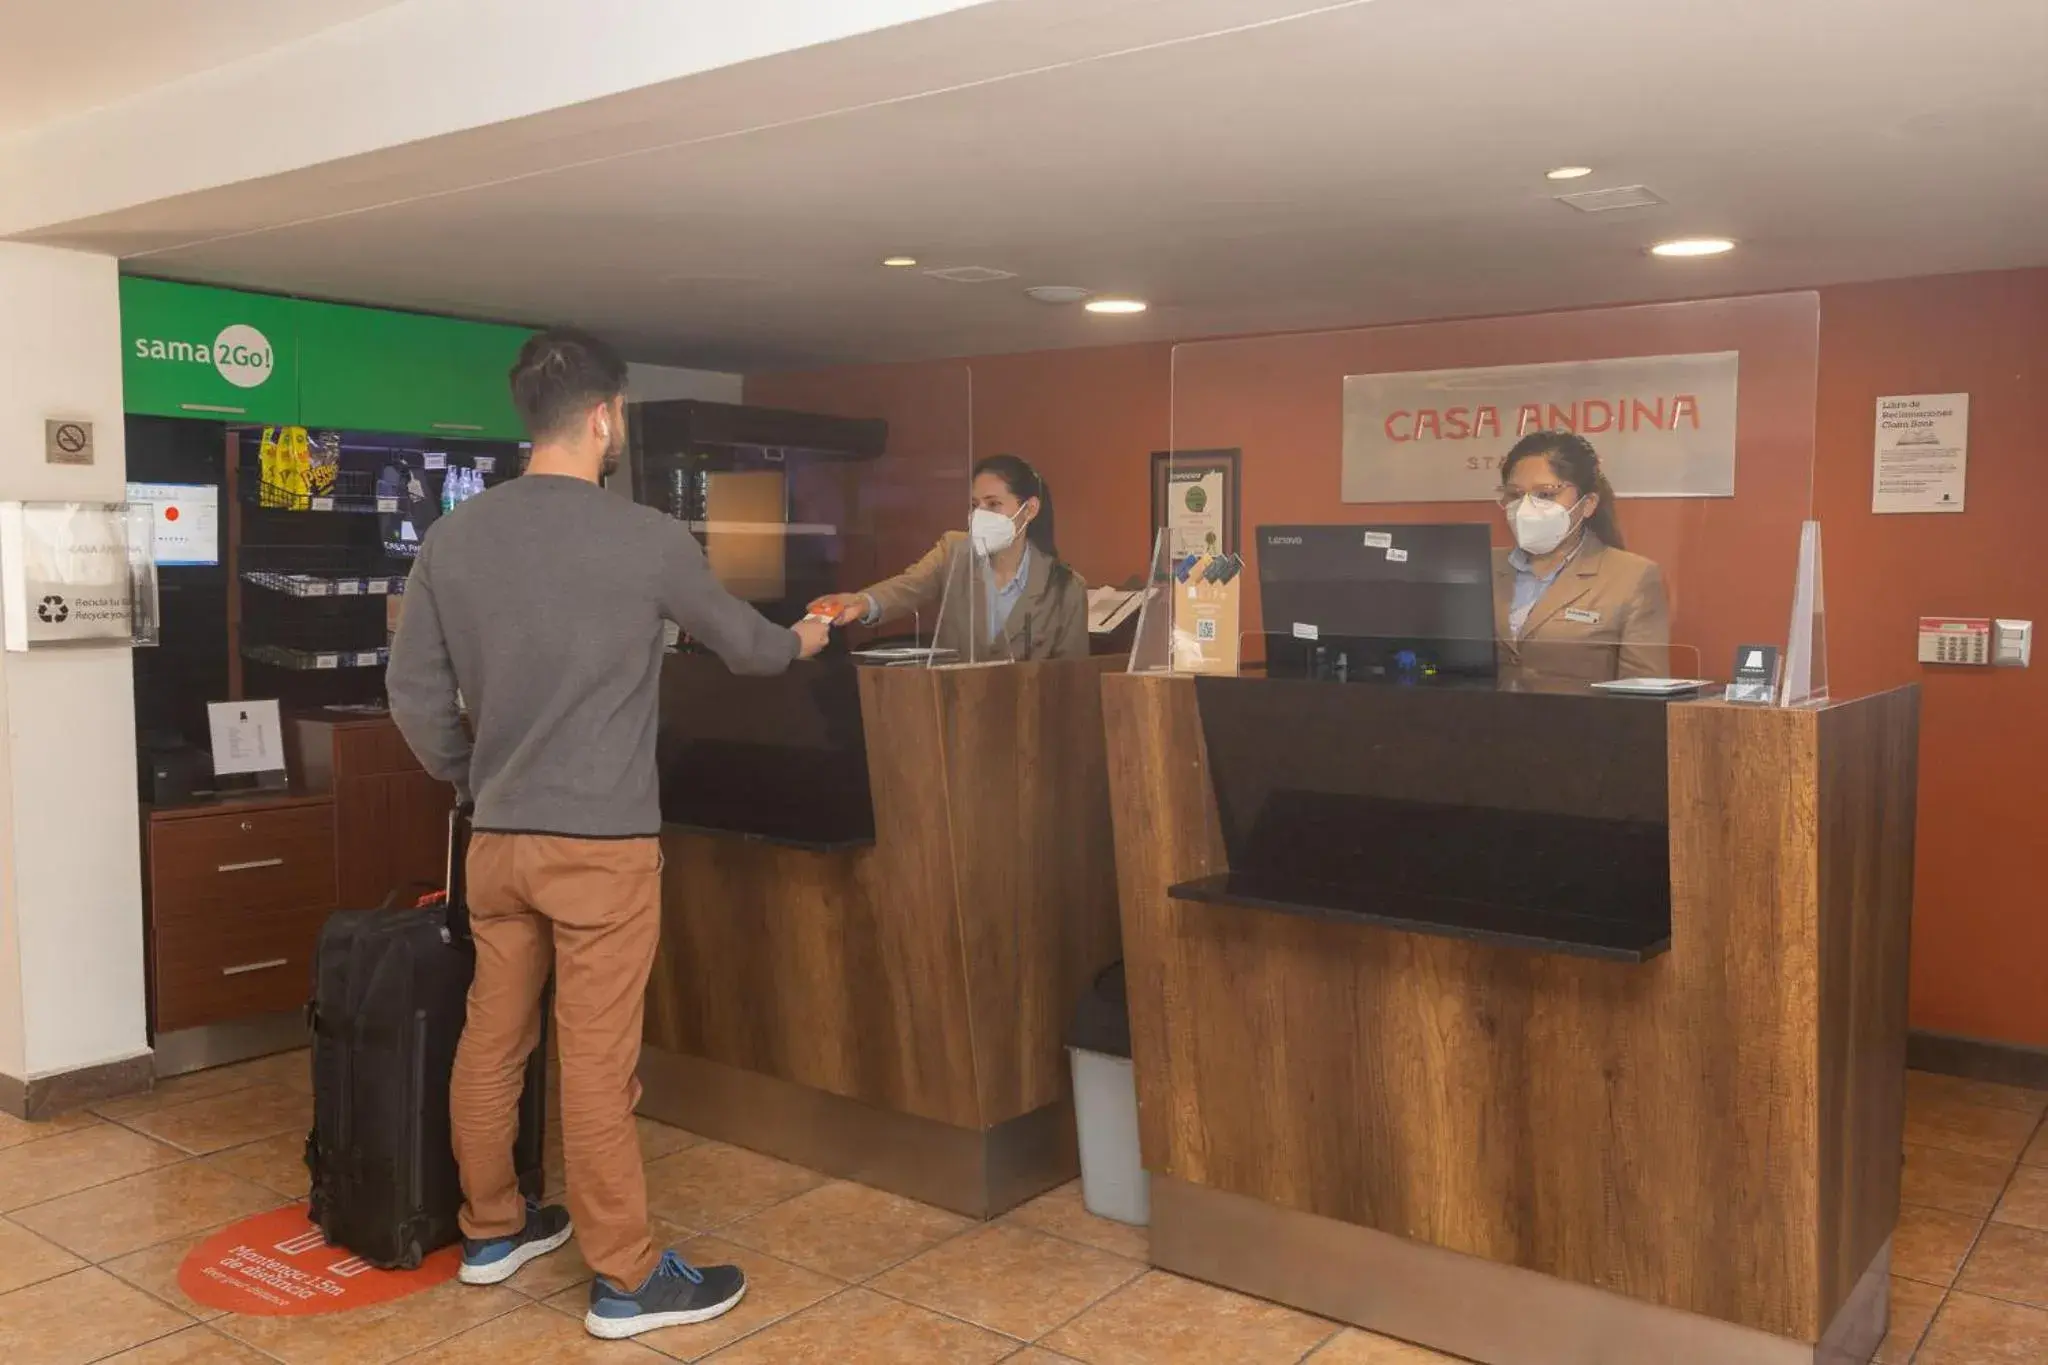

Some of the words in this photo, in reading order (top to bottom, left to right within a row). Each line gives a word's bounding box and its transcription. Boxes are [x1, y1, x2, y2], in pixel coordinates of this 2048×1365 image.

[135, 338, 211, 364] sama
[218, 344, 271, 369] 2Go!
[1384, 404, 1502, 442] CASA
[1516, 394, 1700, 437] ANDINA
[75, 611, 109, 621] Recycle
[220, 1257, 244, 1269] de
[240, 1264, 317, 1300] distancia
[228, 1245, 306, 1284] Mantenga
